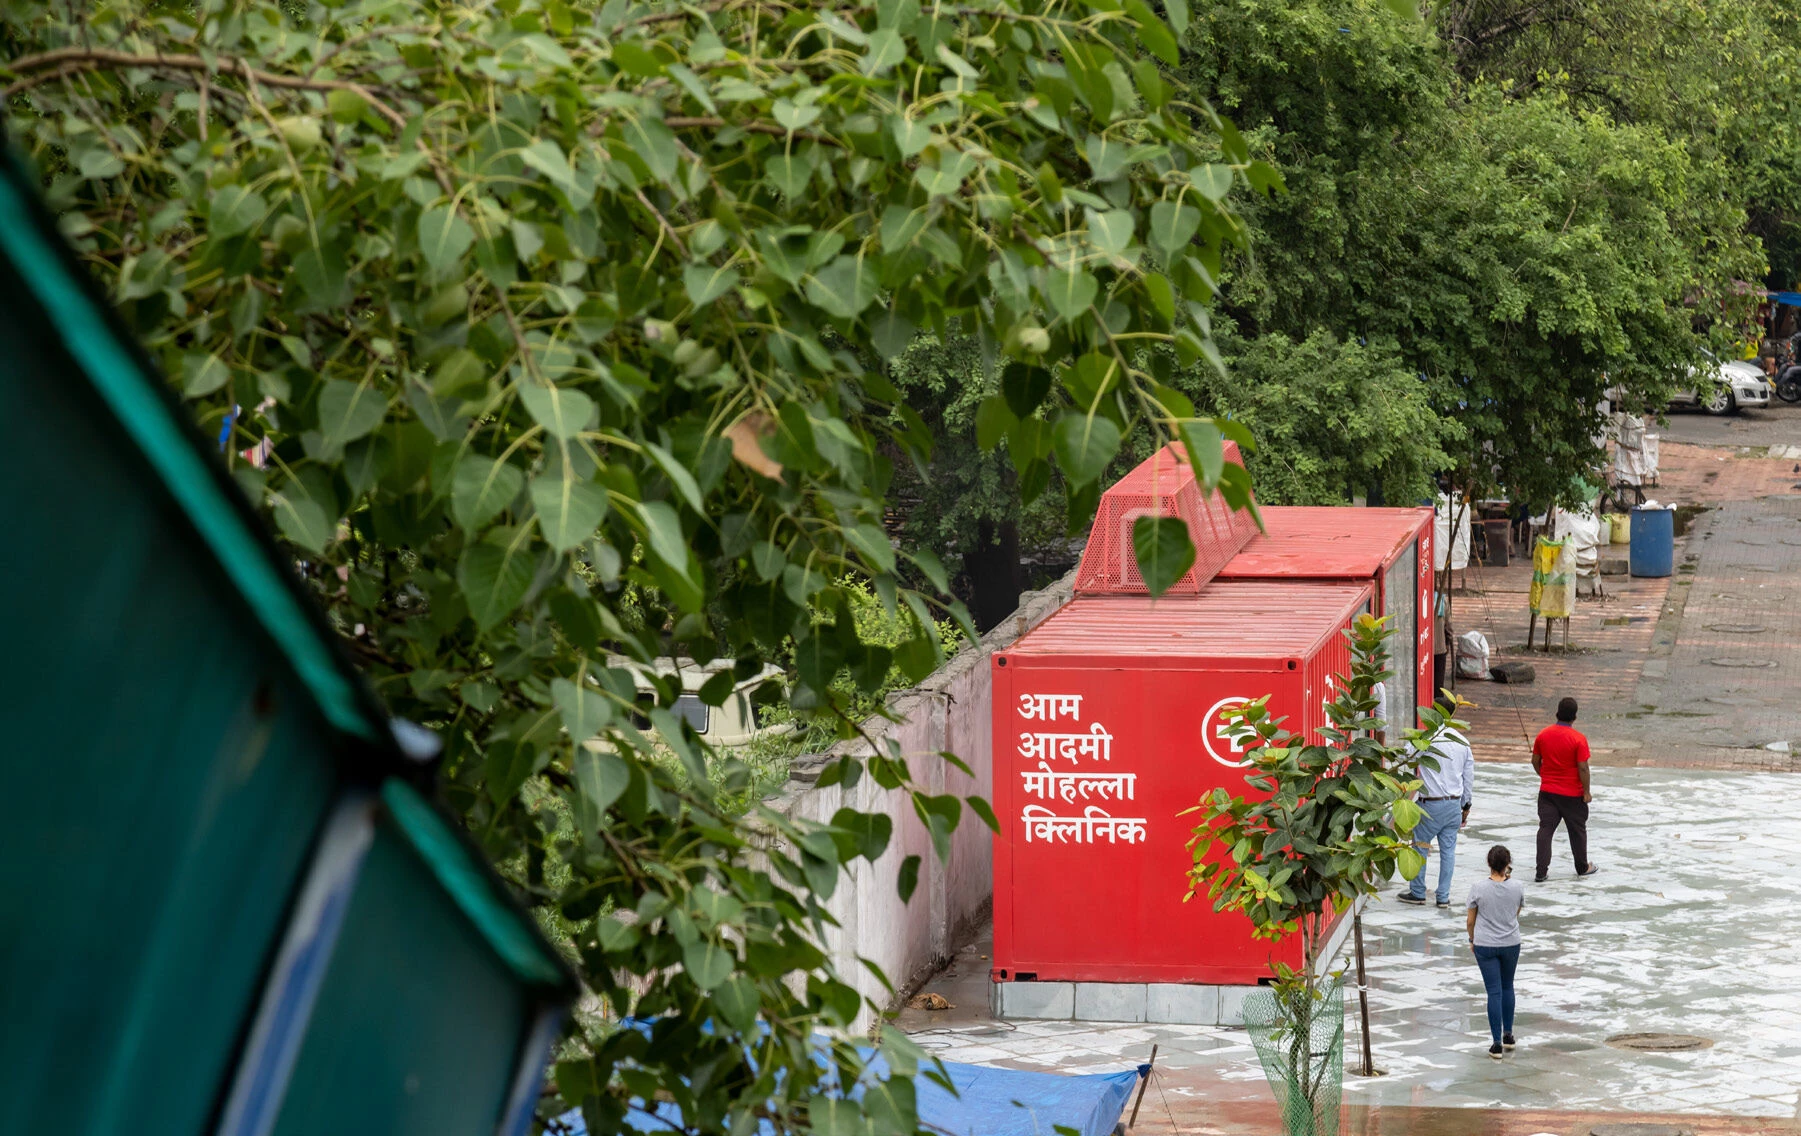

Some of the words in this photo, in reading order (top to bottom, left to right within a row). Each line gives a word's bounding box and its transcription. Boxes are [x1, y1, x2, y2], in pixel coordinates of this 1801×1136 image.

[1017, 694, 1083, 721] आम
[1017, 722, 1113, 765] आदमी
[1021, 761, 1137, 804] मोहल्ला
[1021, 804, 1147, 844] क्लिनिक
